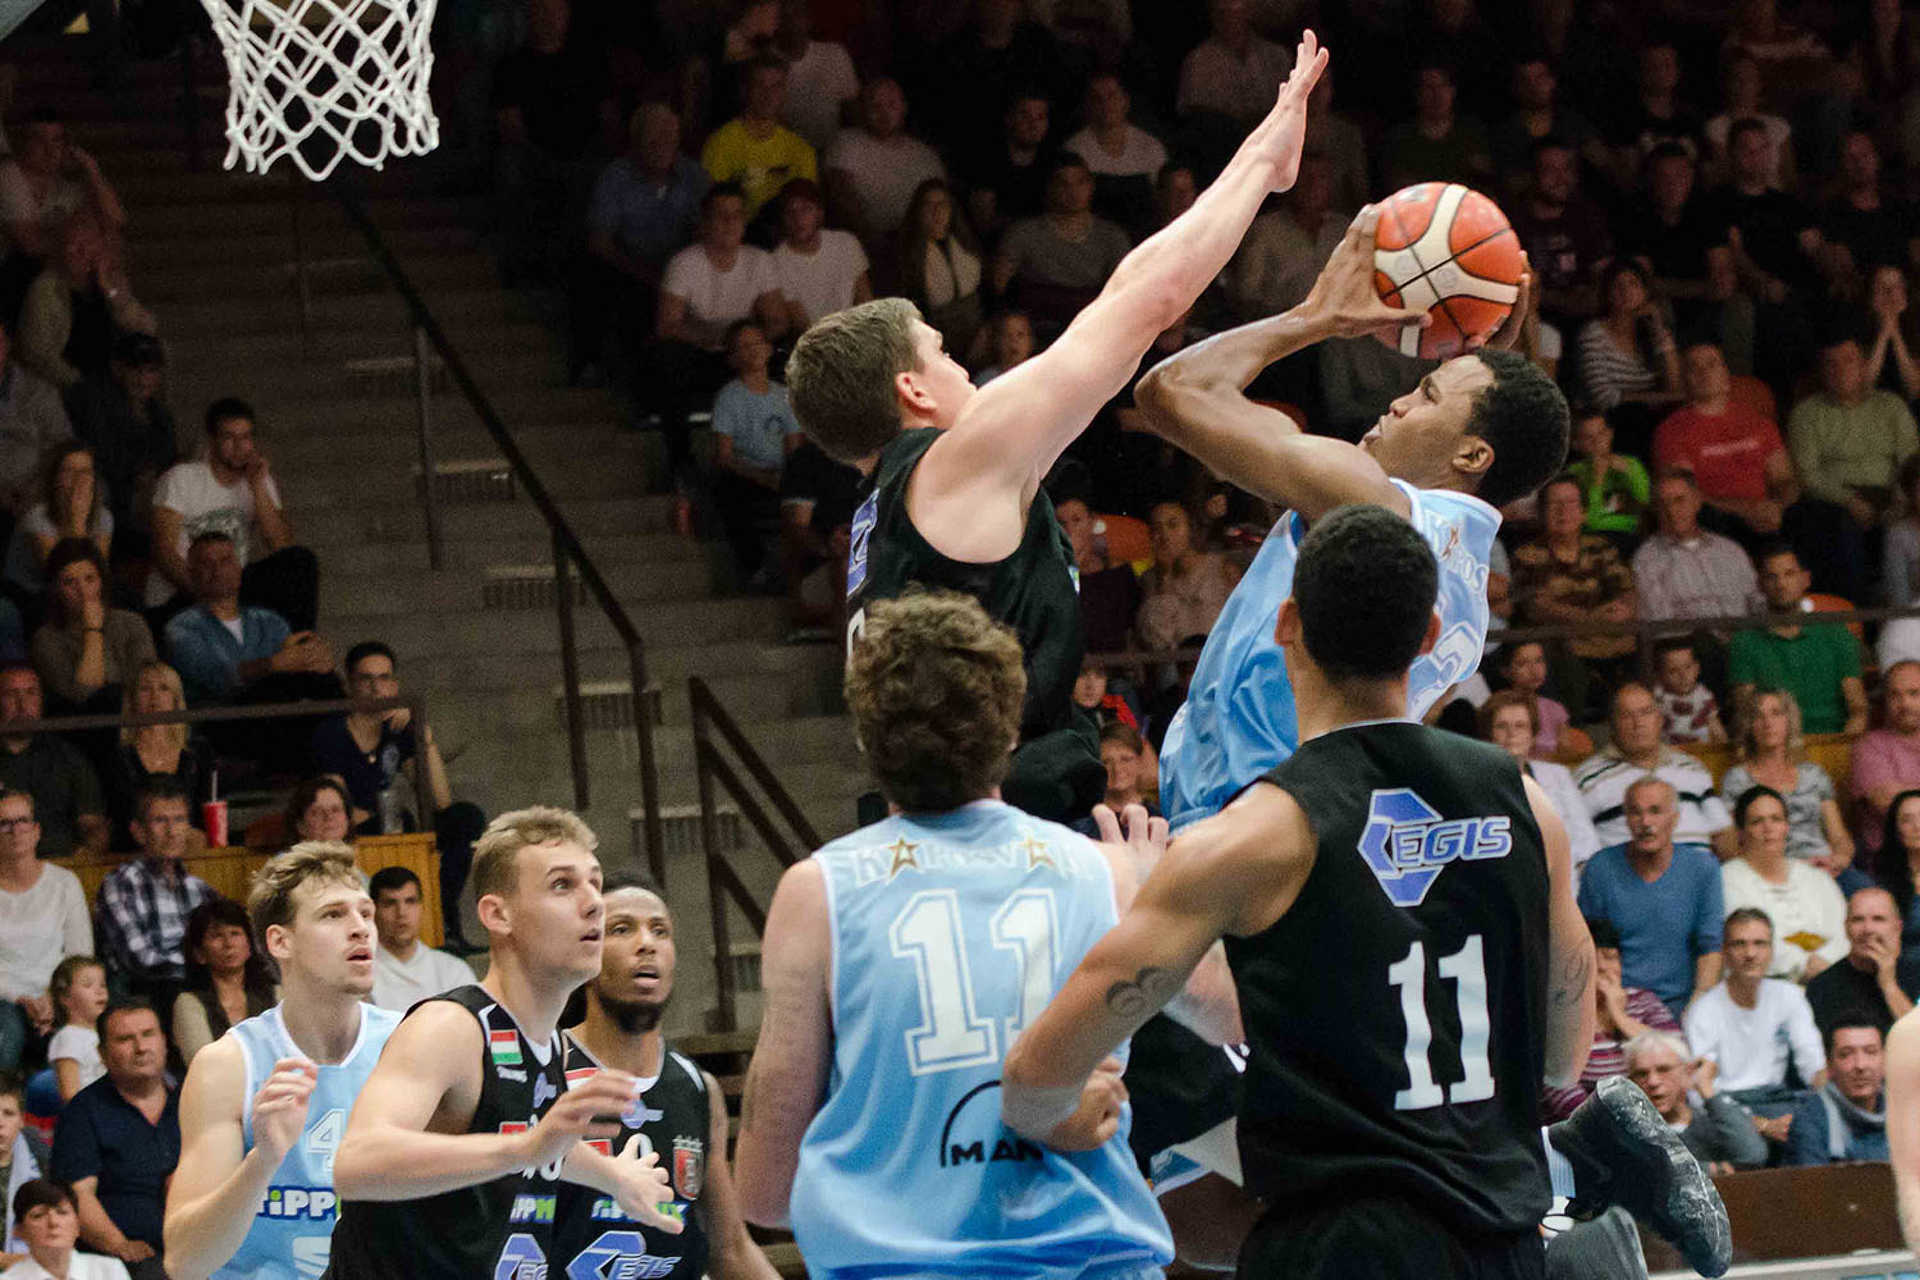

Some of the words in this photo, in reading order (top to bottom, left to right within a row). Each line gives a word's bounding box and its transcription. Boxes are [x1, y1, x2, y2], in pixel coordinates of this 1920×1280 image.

[889, 887, 1062, 1077] 11
[1388, 934, 1496, 1111] 11
[951, 1139, 1044, 1167] MAN
